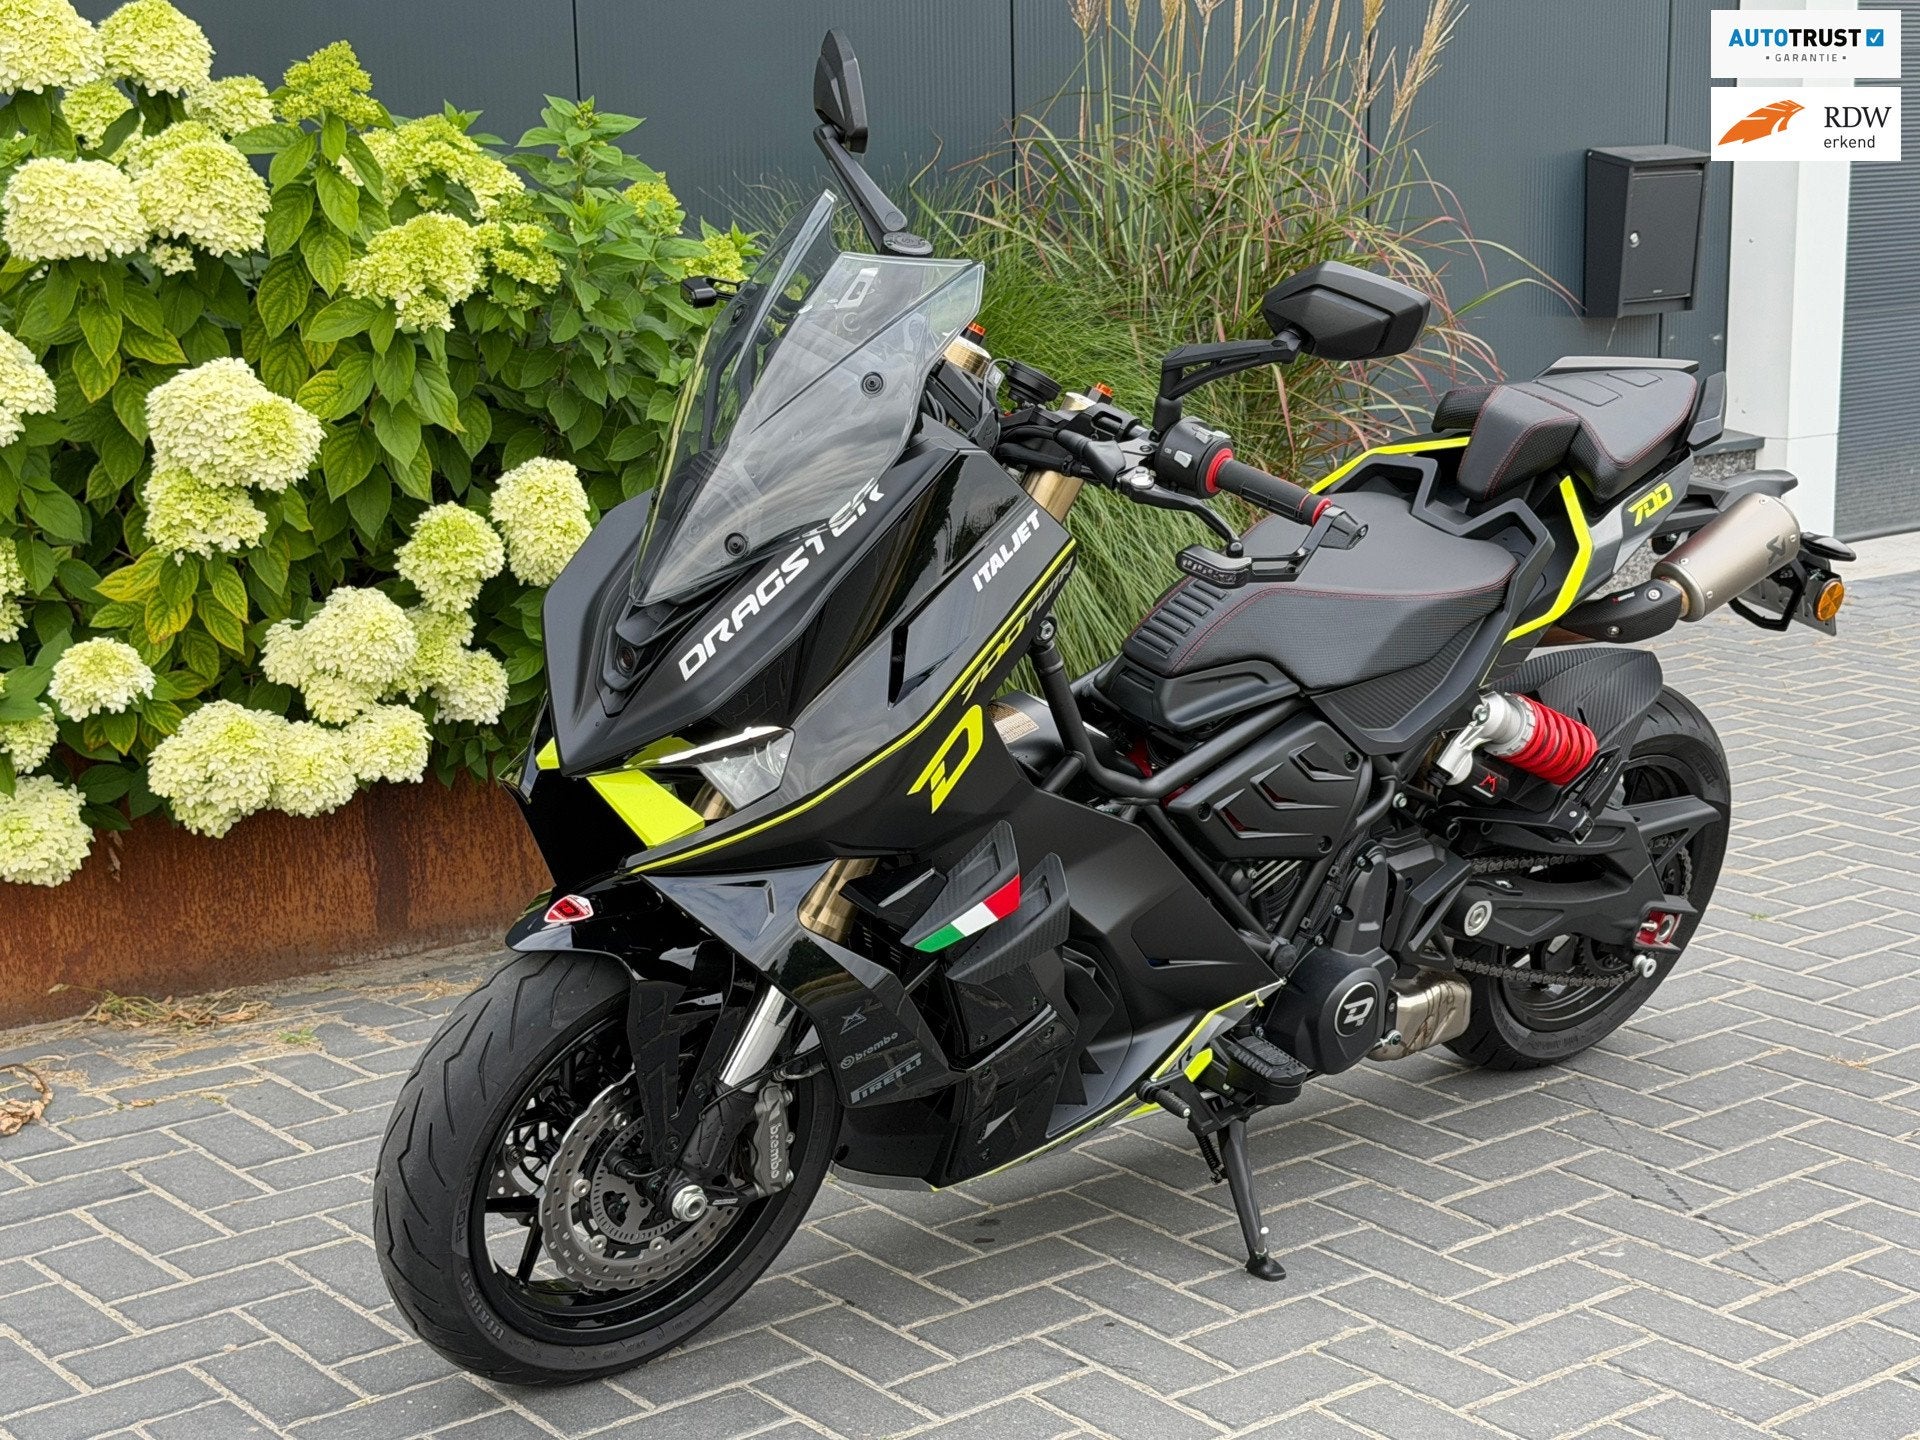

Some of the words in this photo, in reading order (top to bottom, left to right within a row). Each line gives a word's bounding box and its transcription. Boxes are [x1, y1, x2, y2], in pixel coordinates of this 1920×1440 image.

[1628, 482, 1674, 527] 700
[972, 509, 1041, 592] ITALJET
[678, 477, 884, 682] DRAGSTER
[854, 1032, 898, 1062] brembo
[850, 1052, 922, 1104] PIRELLI
[769, 1122, 783, 1179] brembo
